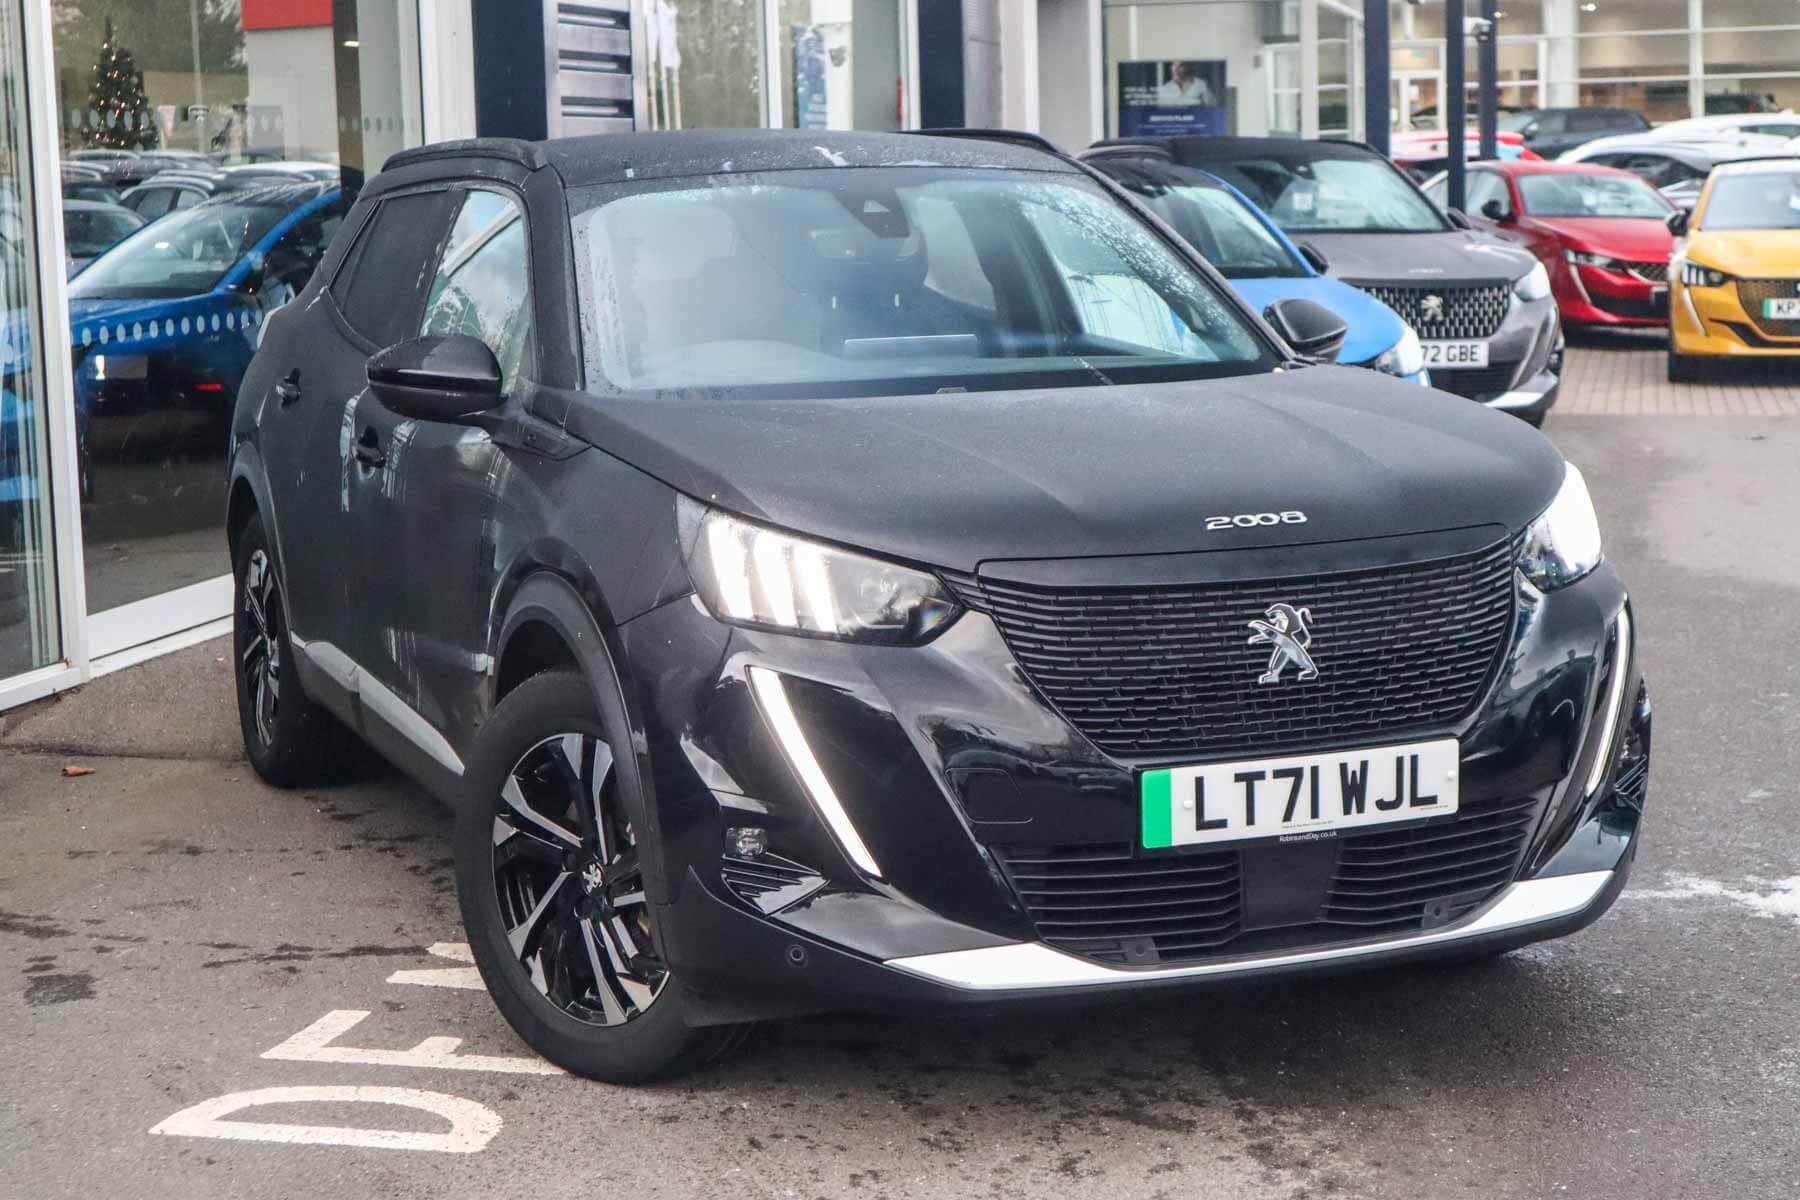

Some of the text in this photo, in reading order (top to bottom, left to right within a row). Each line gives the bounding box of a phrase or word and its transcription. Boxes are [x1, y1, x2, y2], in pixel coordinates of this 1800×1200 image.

[1446, 344, 1480, 362] GBE
[1203, 510, 1308, 530] 2008
[1194, 753, 1439, 832] LT71 WJL
